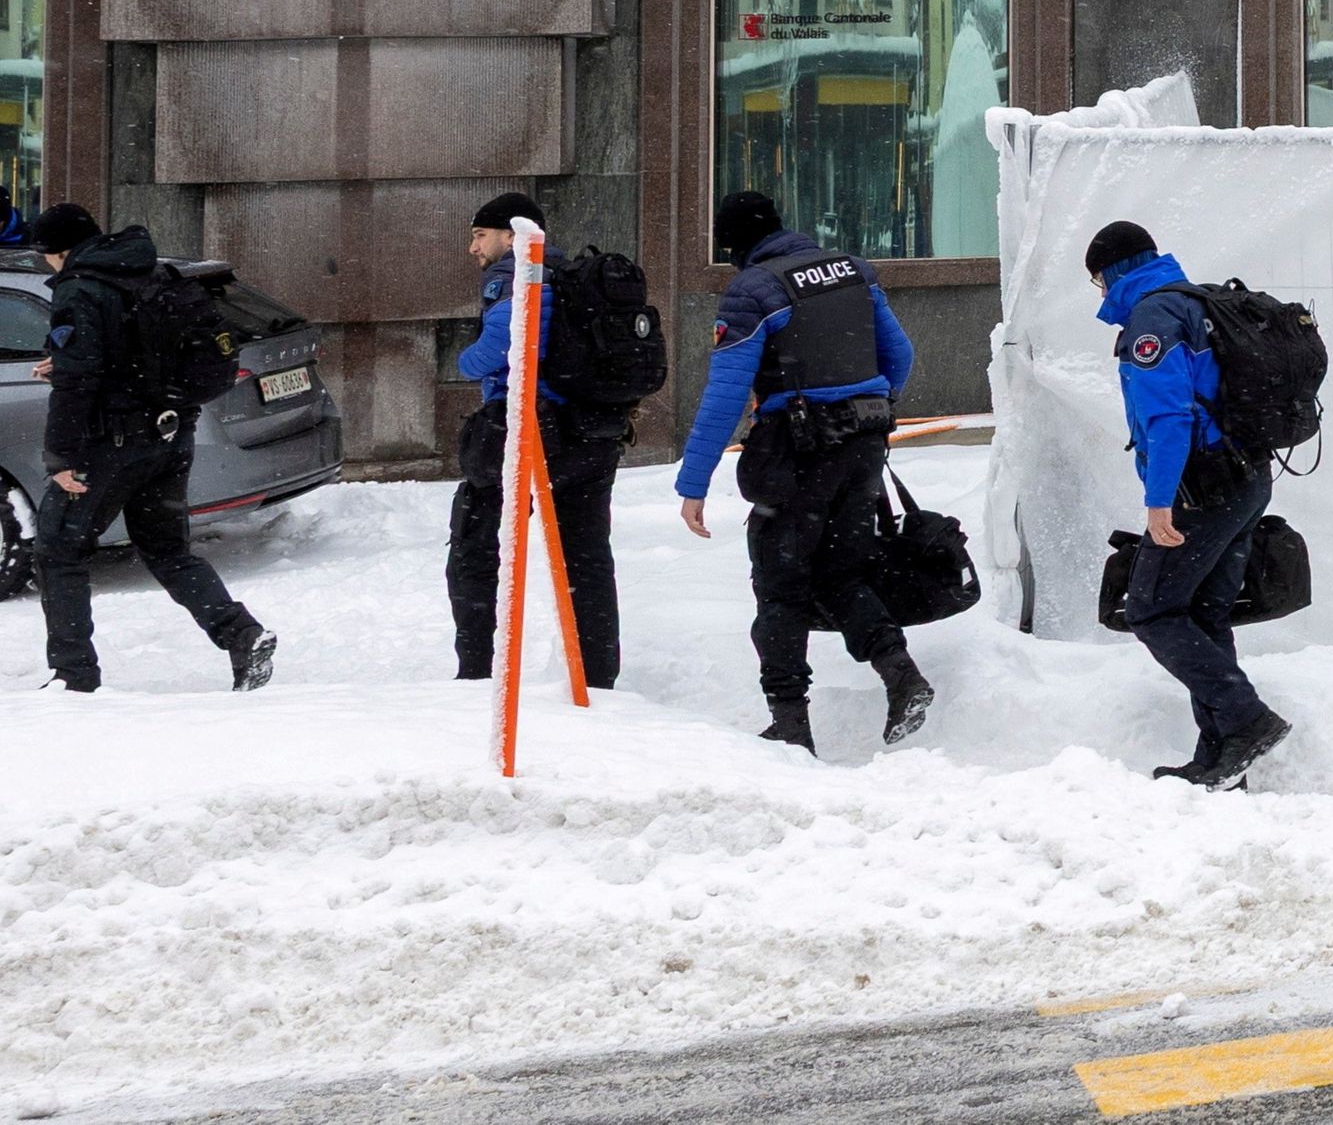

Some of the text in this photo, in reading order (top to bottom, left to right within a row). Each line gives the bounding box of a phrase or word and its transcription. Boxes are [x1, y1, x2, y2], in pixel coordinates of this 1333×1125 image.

[770, 11, 892, 28] Banque Cantonale
[770, 27, 830, 40] du Valais
[792, 260, 856, 288] POLICE
